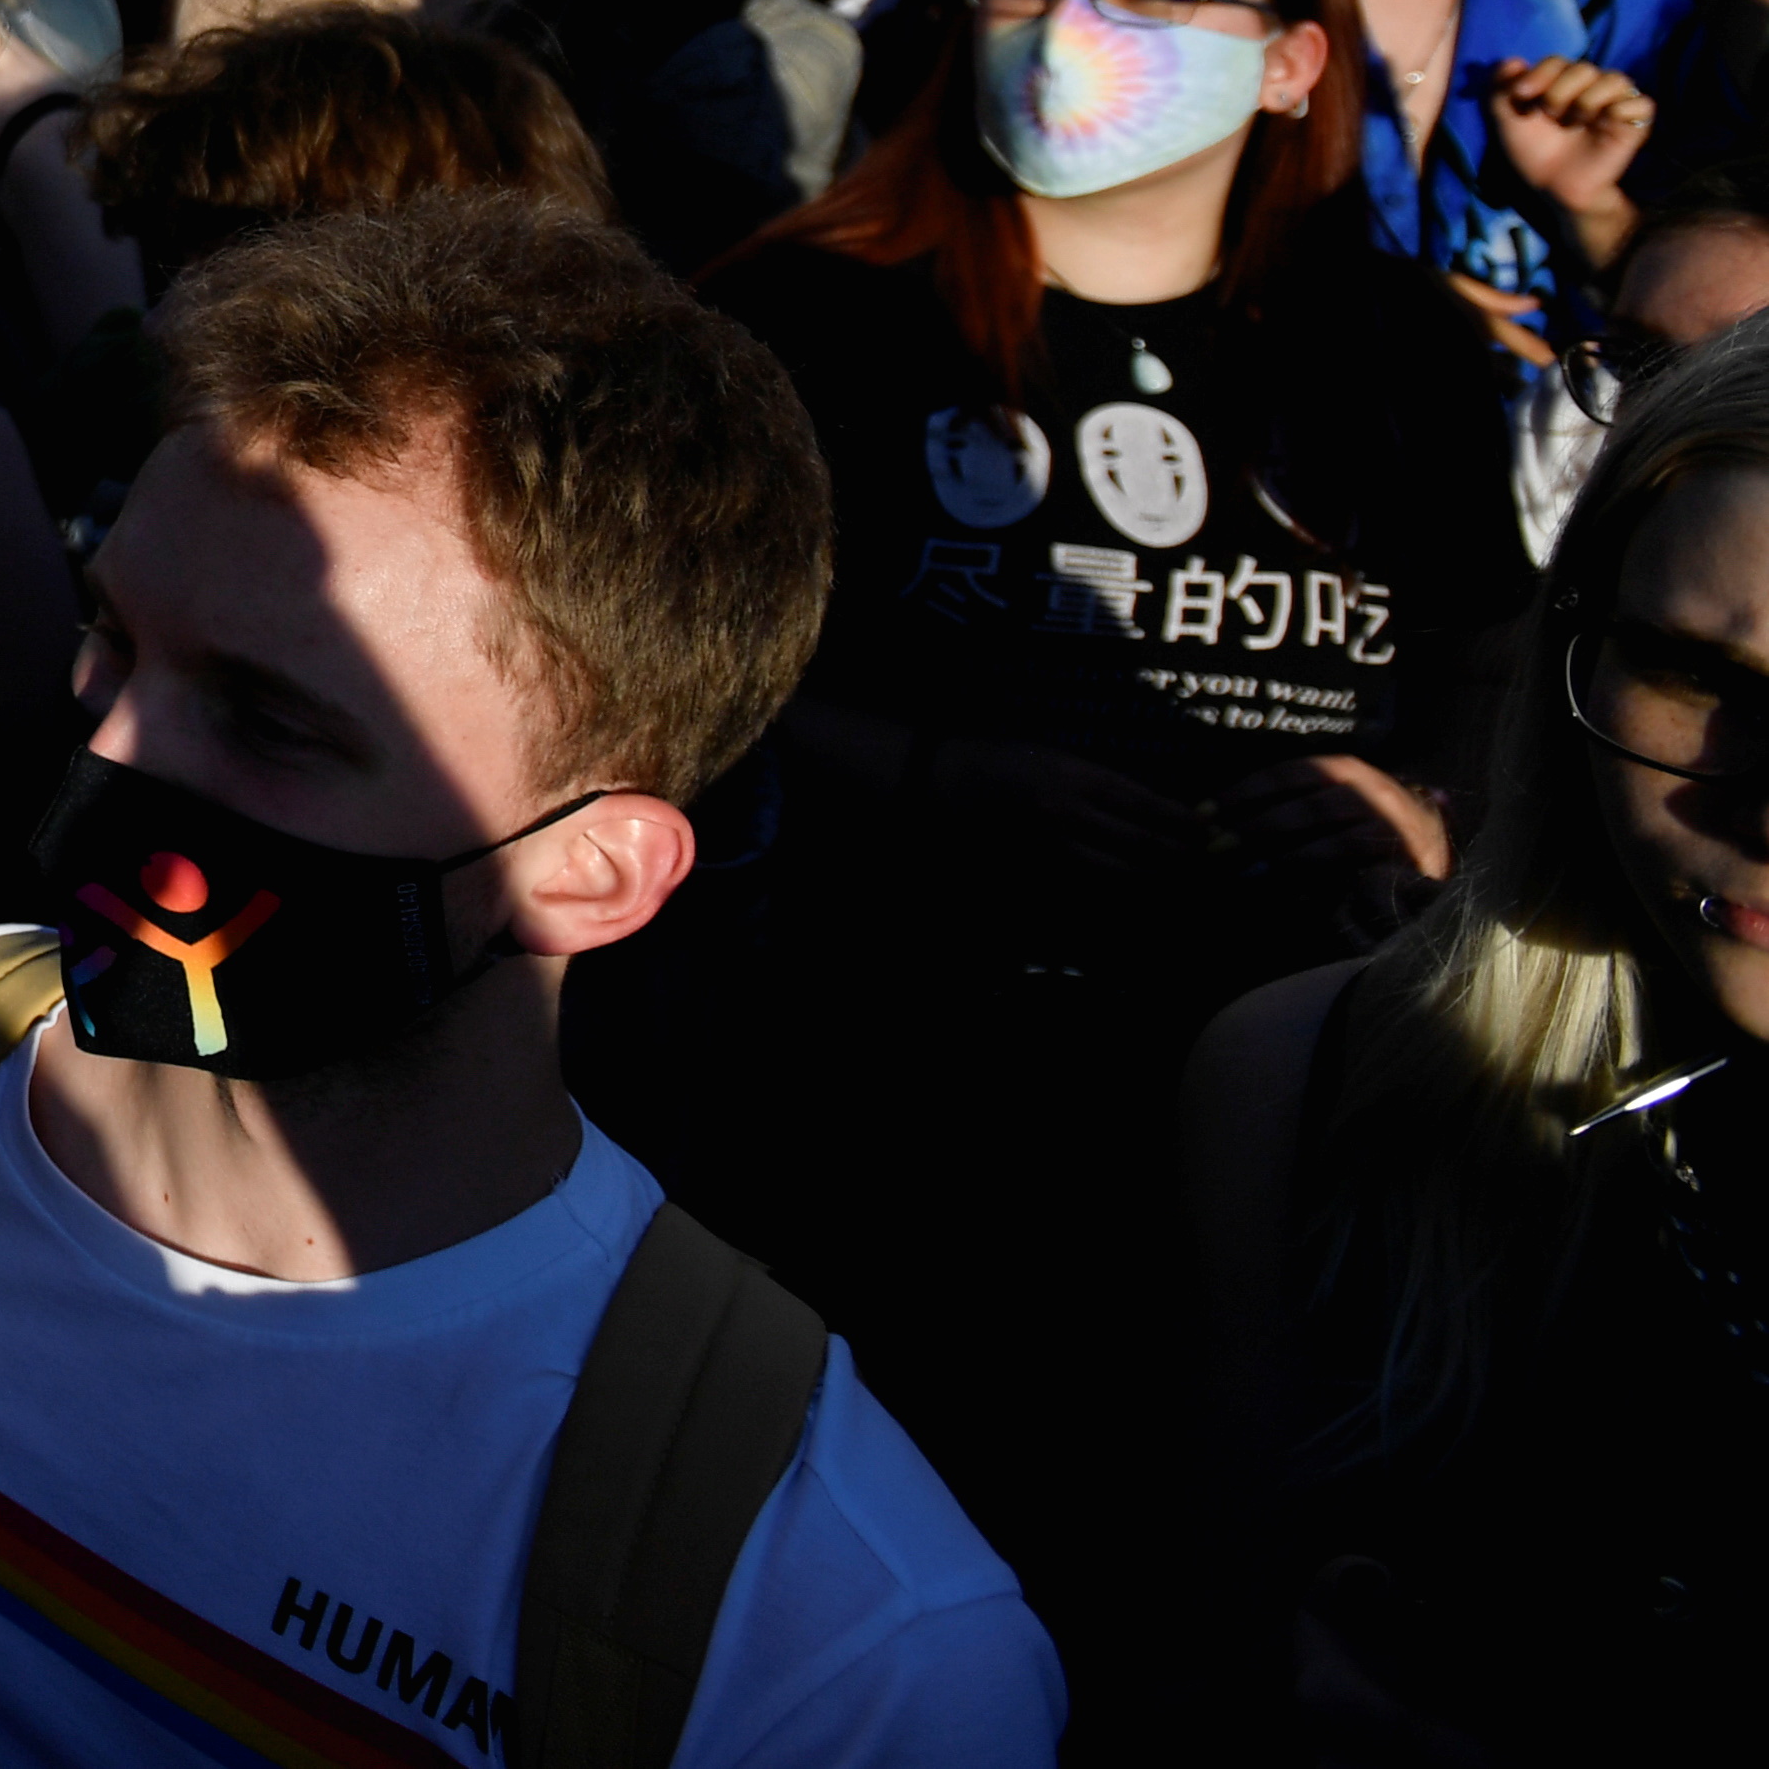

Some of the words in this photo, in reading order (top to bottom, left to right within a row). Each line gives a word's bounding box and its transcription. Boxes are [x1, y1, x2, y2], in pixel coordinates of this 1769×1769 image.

[899, 537, 1397, 666] 尽量的吃
[1175, 671, 1258, 699] you
[1222, 704, 1264, 729] to
